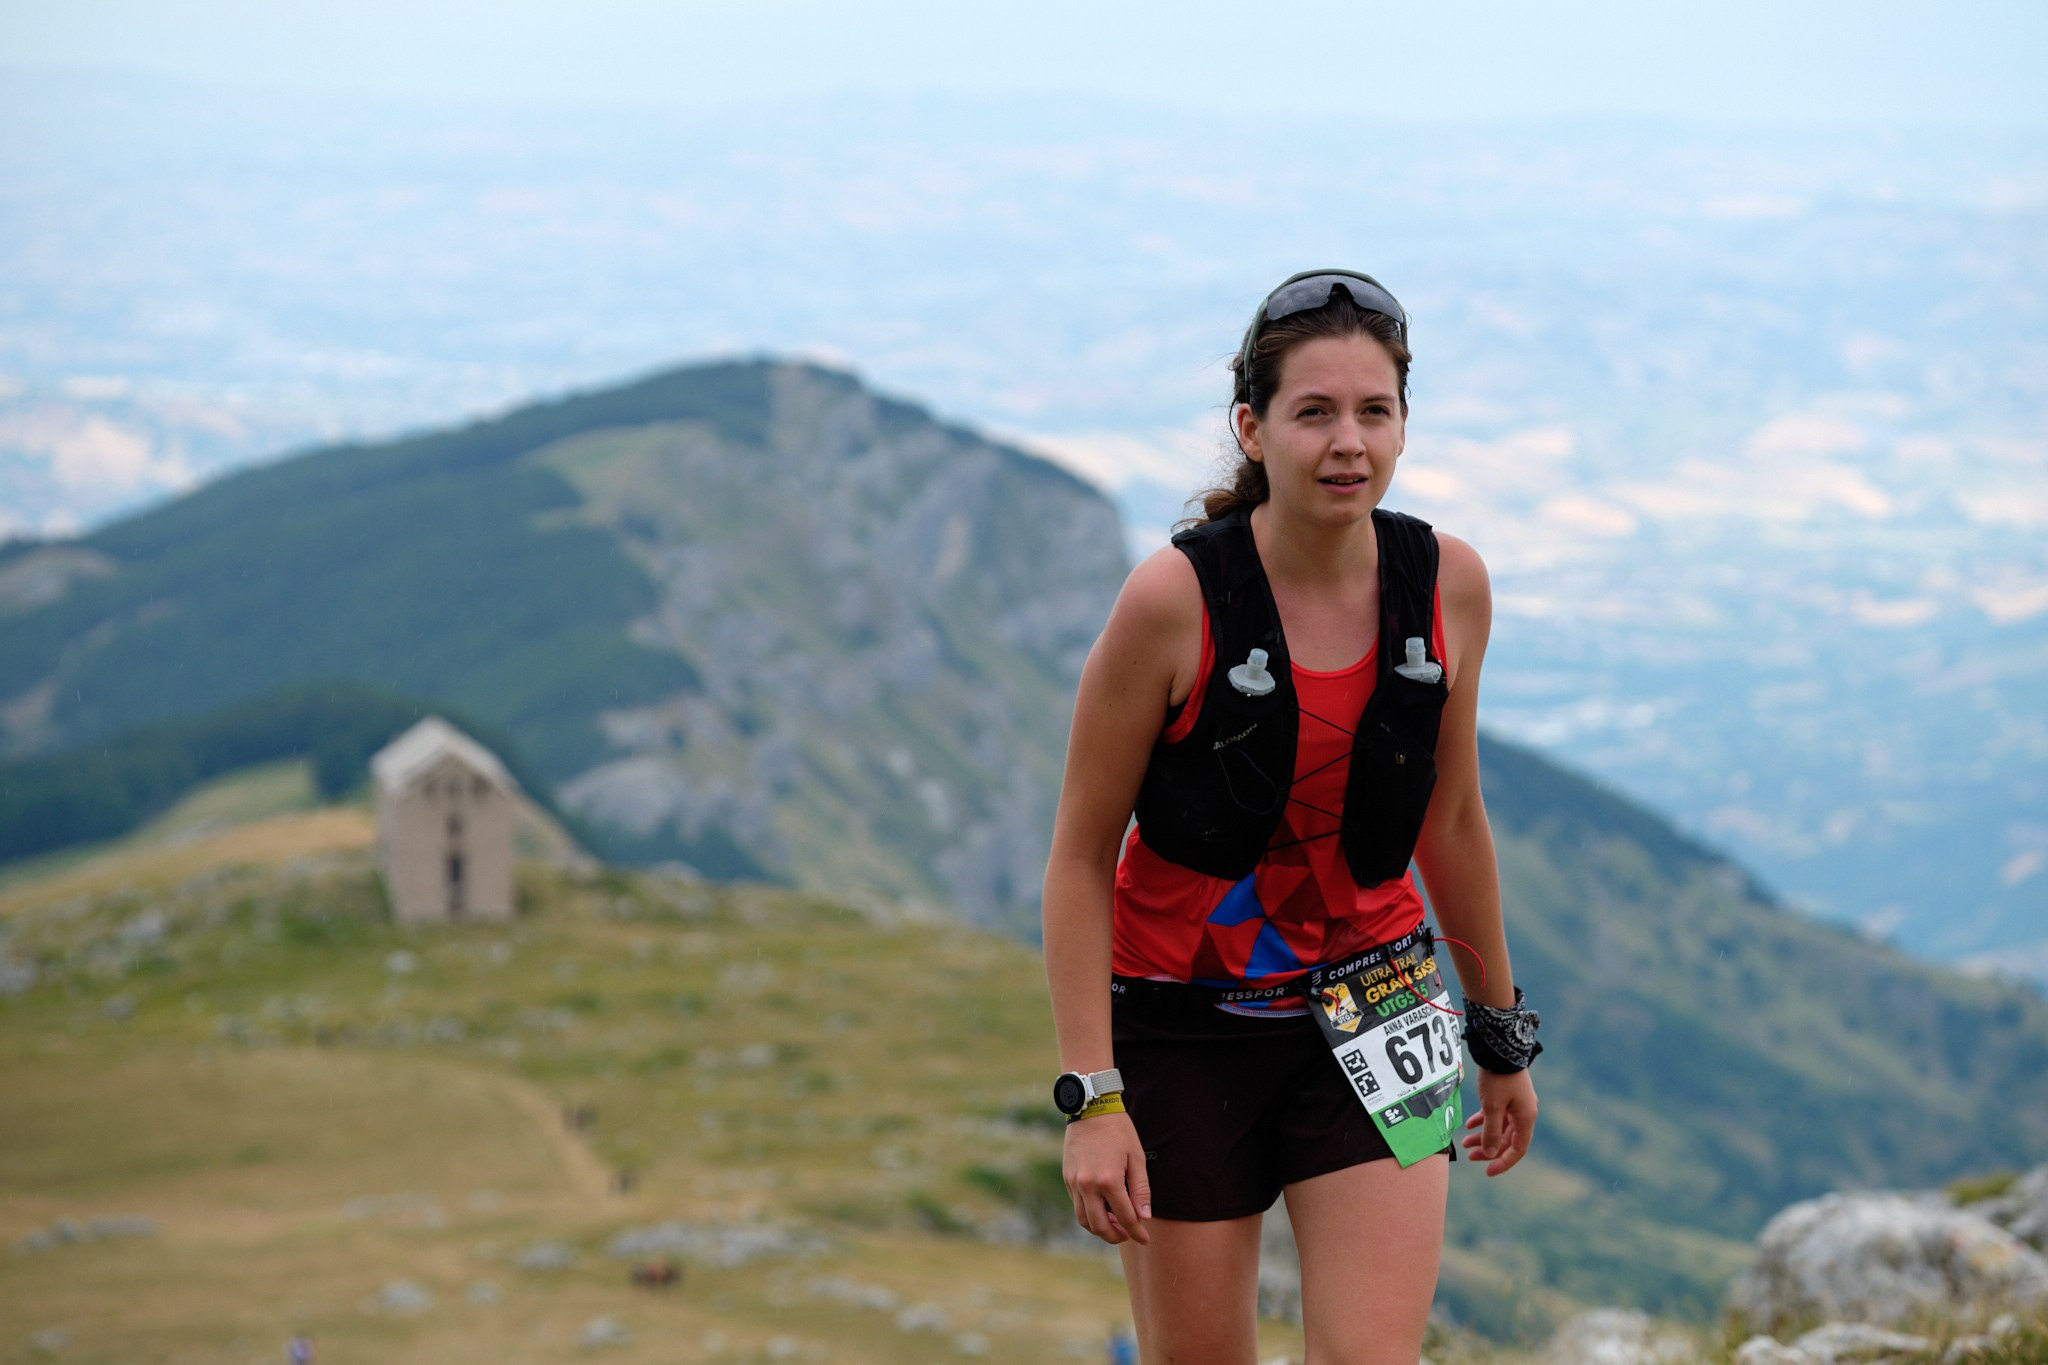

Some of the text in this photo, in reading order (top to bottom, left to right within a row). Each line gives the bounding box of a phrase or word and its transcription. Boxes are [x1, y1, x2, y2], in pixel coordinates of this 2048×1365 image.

[1360, 964, 1394, 987] ULTRA
[1365, 971, 1413, 1004] GRAN
[1383, 1019, 1405, 1036] ANNA
[1385, 1015, 1453, 1085] 673
